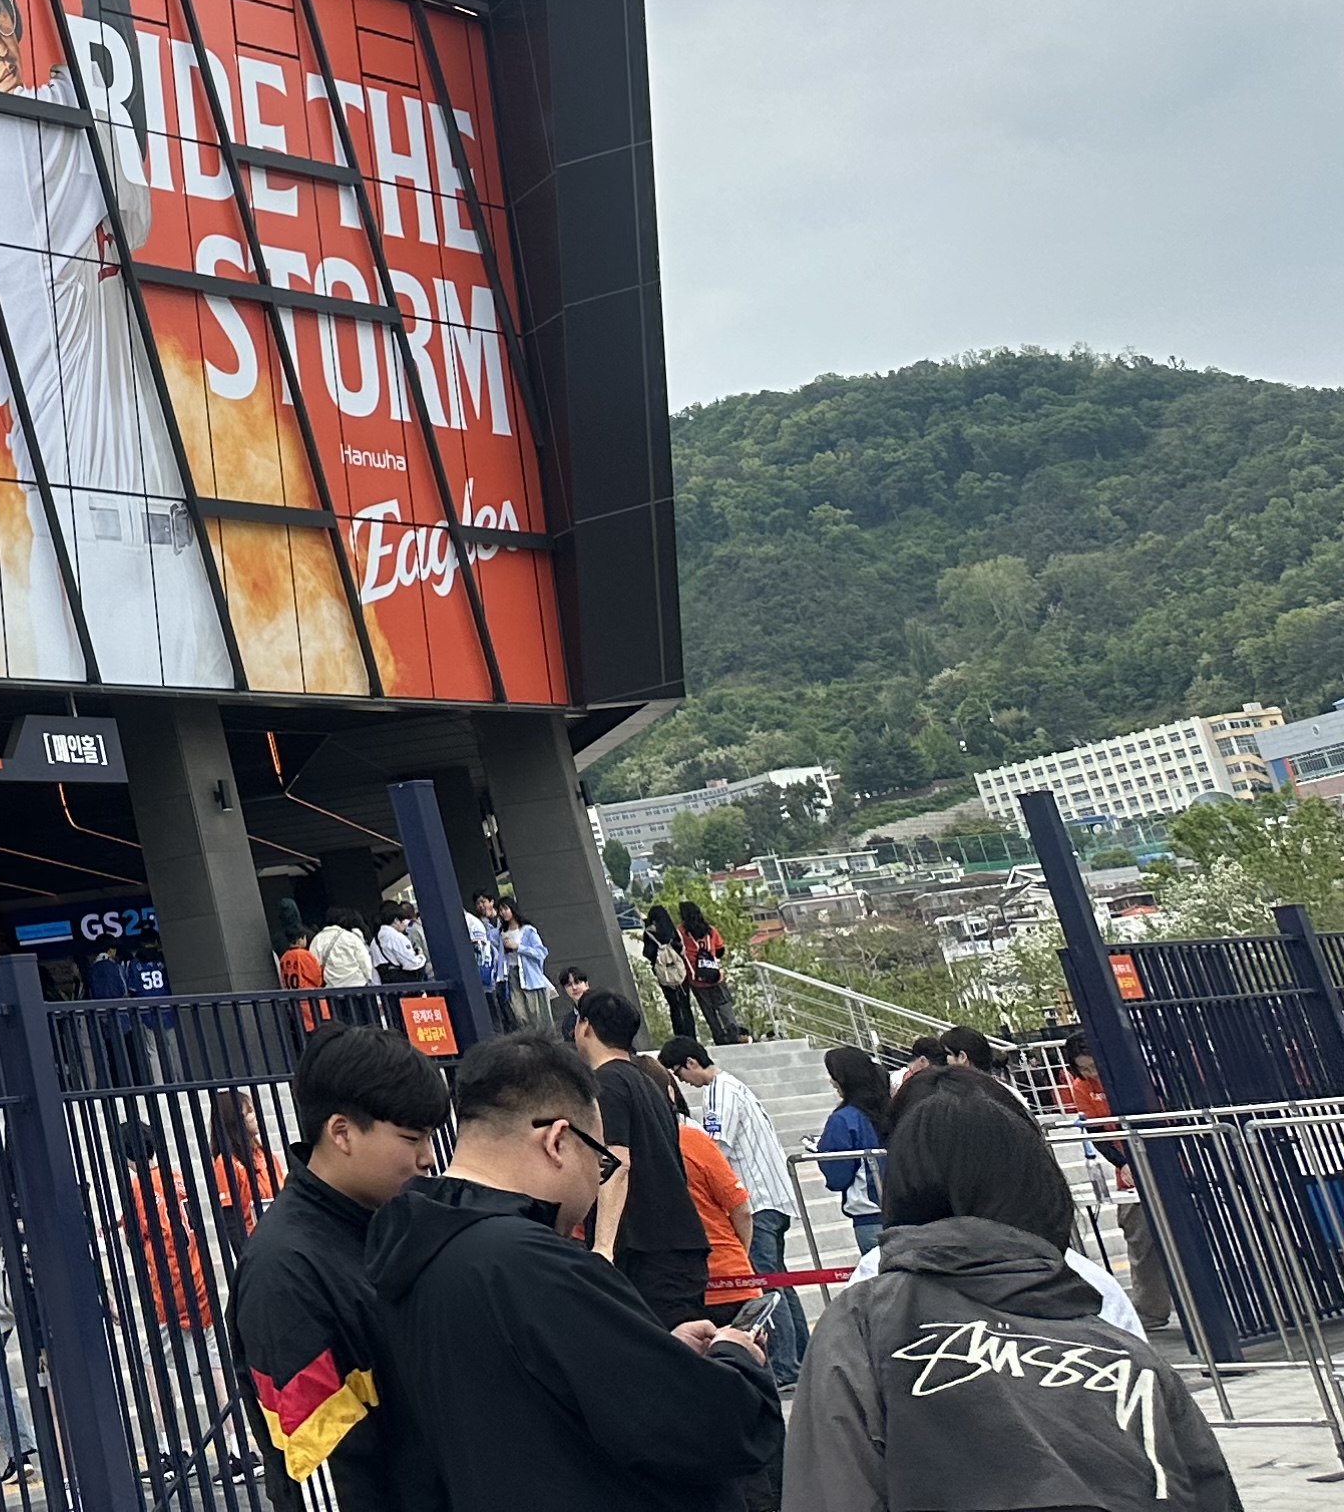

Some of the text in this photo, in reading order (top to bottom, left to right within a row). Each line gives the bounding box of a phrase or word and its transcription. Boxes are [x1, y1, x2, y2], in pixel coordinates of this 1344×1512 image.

[64, 14, 482, 255] RIDE THE
[194, 235, 513, 438] STORM
[340, 443, 407, 472] Hanwha
[349, 477, 520, 605] Eagles
[141, 970, 164, 990] 58
